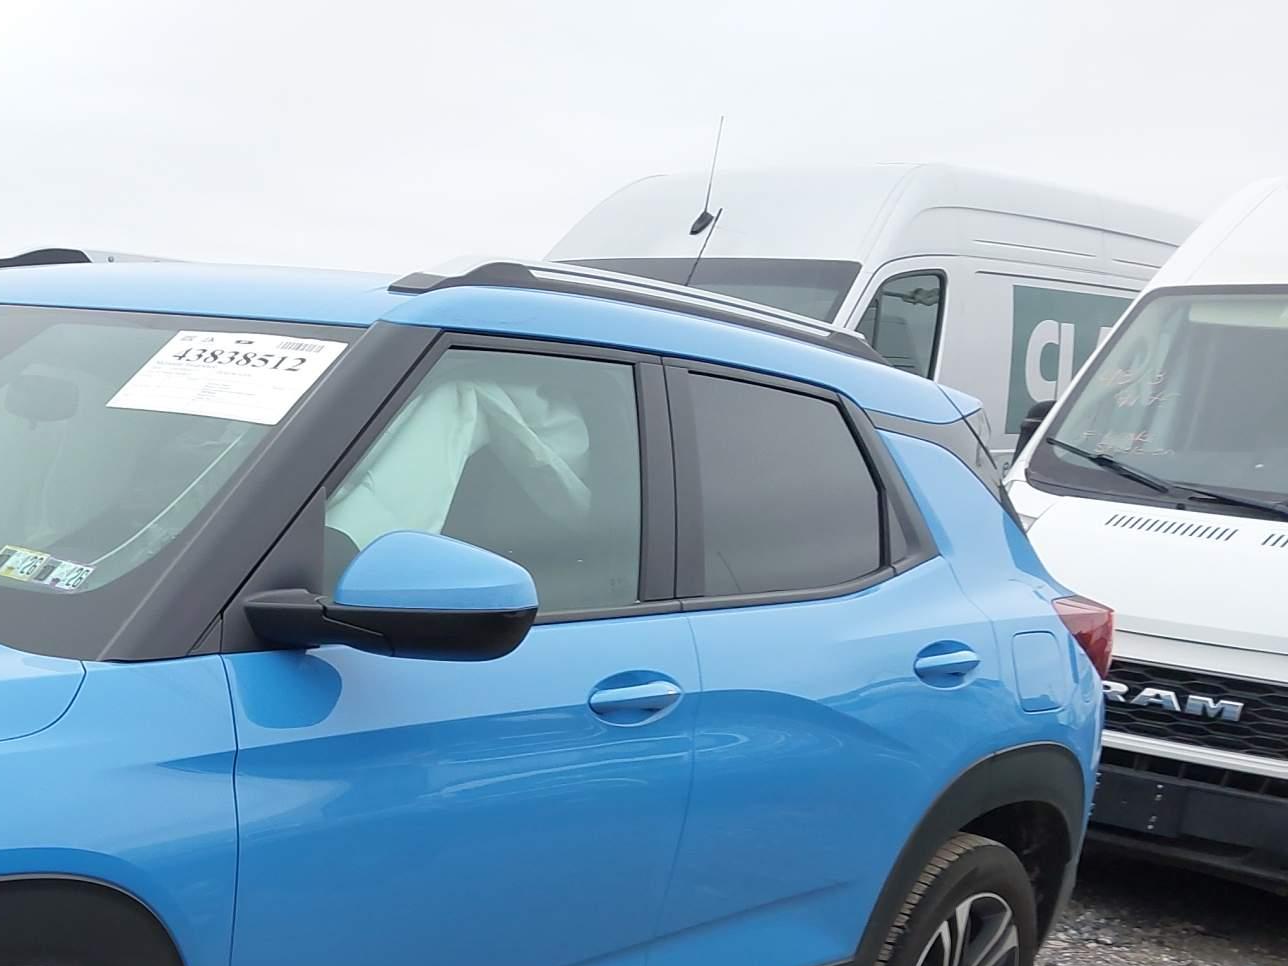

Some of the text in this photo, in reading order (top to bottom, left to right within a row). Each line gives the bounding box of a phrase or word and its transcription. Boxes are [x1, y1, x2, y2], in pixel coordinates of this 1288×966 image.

[171, 347, 307, 372] 43838512
[1025, 319, 1114, 402] CL
[1102, 680, 1244, 722] RAM
